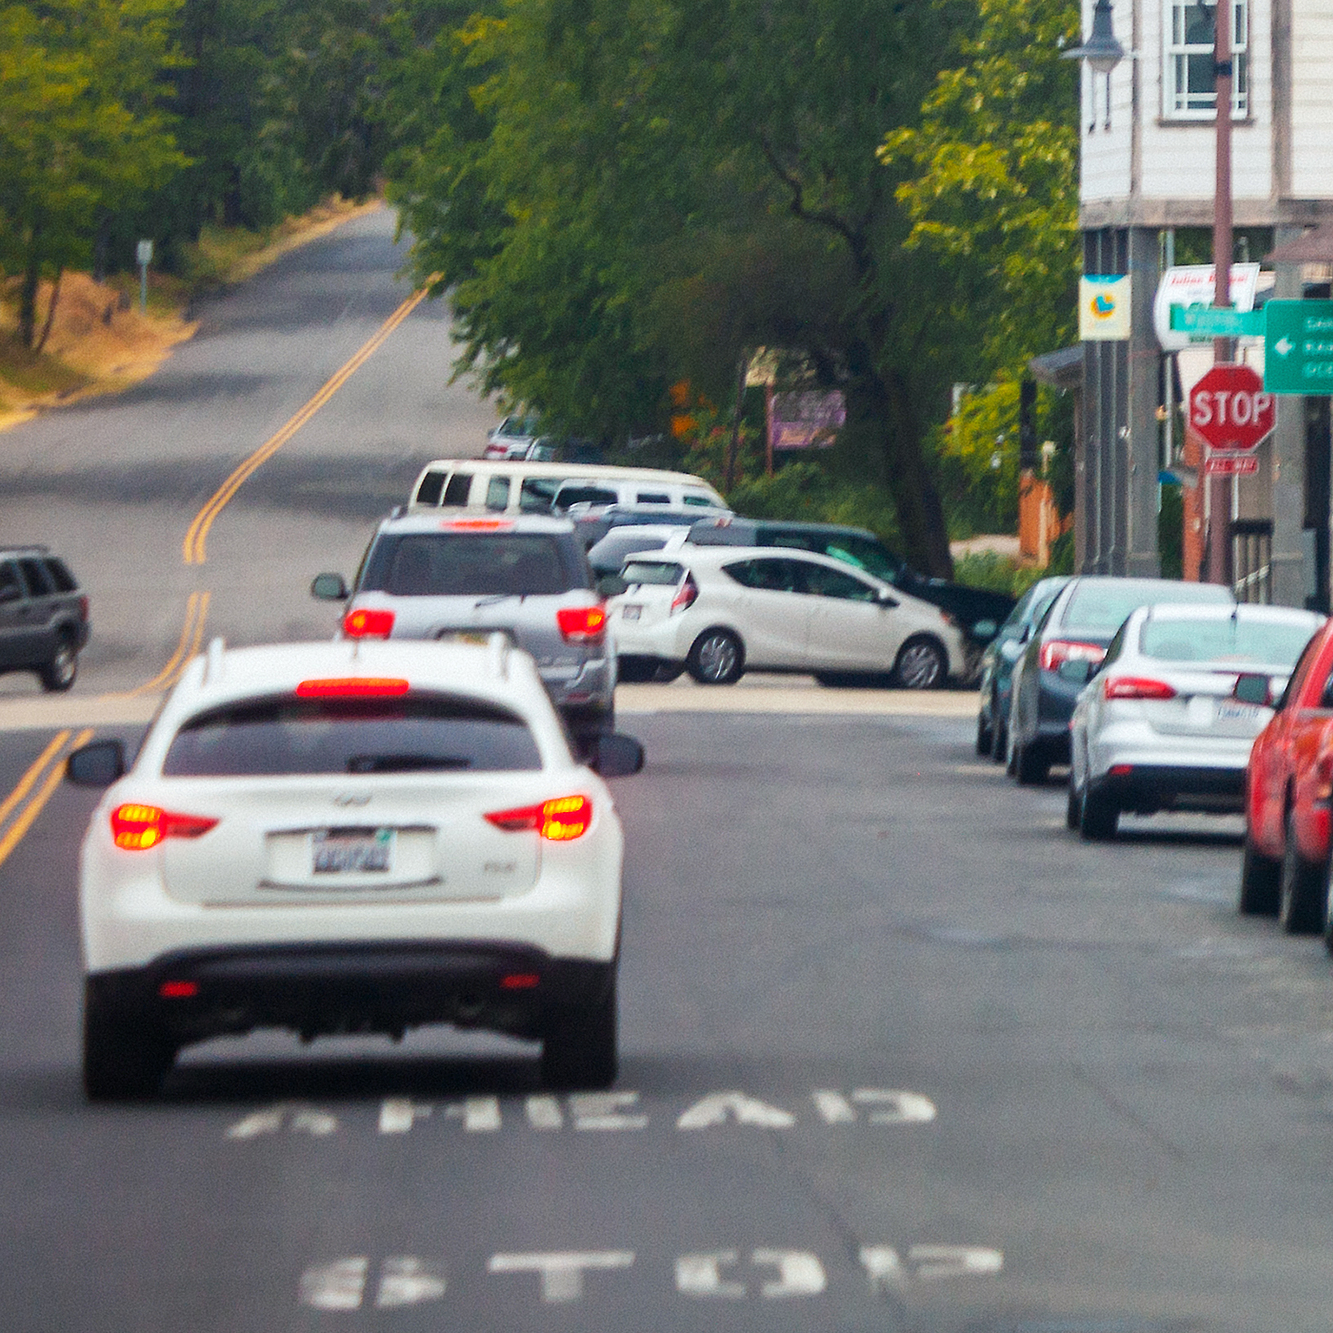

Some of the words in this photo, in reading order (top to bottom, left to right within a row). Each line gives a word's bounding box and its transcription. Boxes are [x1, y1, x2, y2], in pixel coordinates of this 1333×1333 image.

[1193, 390, 1272, 427] STOP
[226, 1090, 937, 1139] AHEAD
[300, 1245, 1003, 1311] STOP
